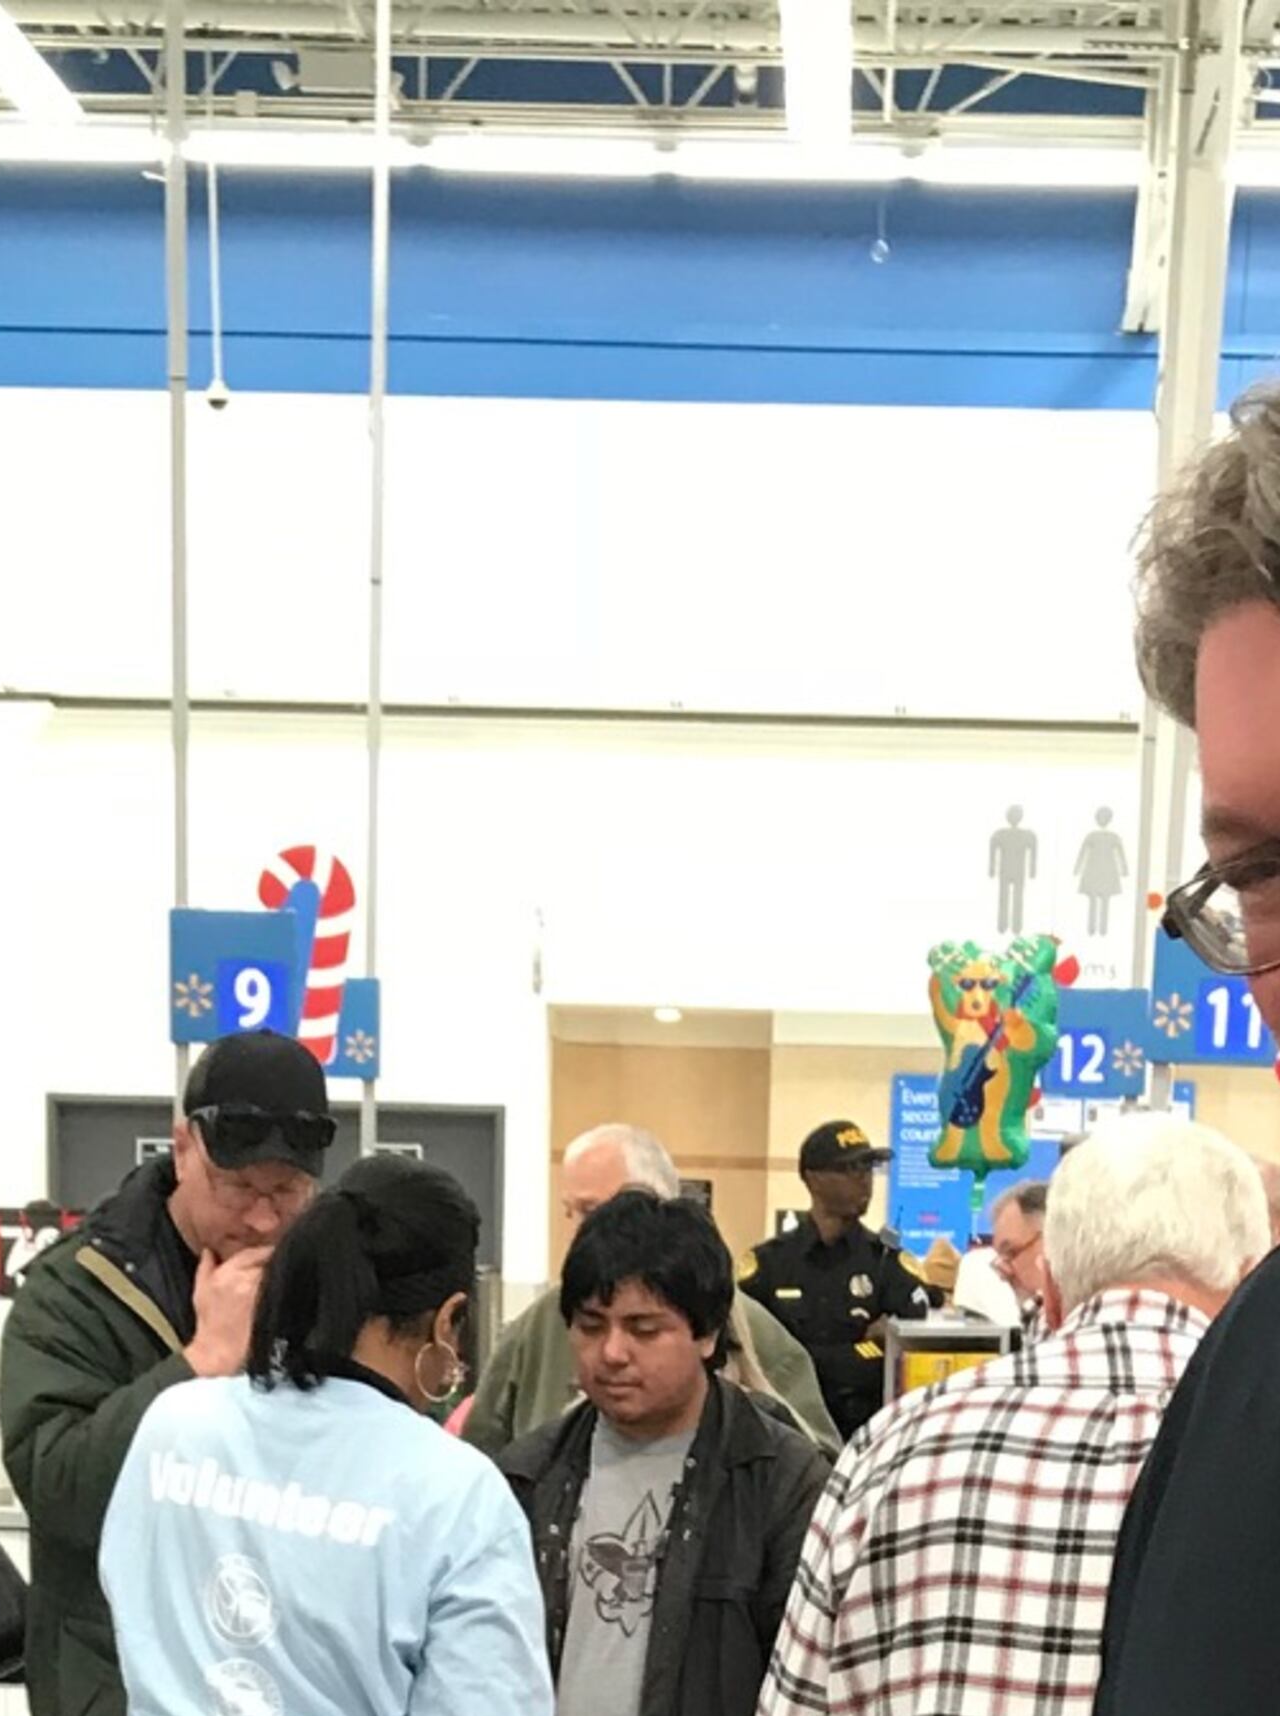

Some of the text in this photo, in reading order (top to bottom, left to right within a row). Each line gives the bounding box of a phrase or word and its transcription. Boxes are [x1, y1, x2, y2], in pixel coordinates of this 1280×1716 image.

[233, 968, 271, 1028] 9
[1206, 986, 1262, 1048] 11
[1056, 1033, 1107, 1085] 12
[149, 1449, 396, 1547] Volunteer
